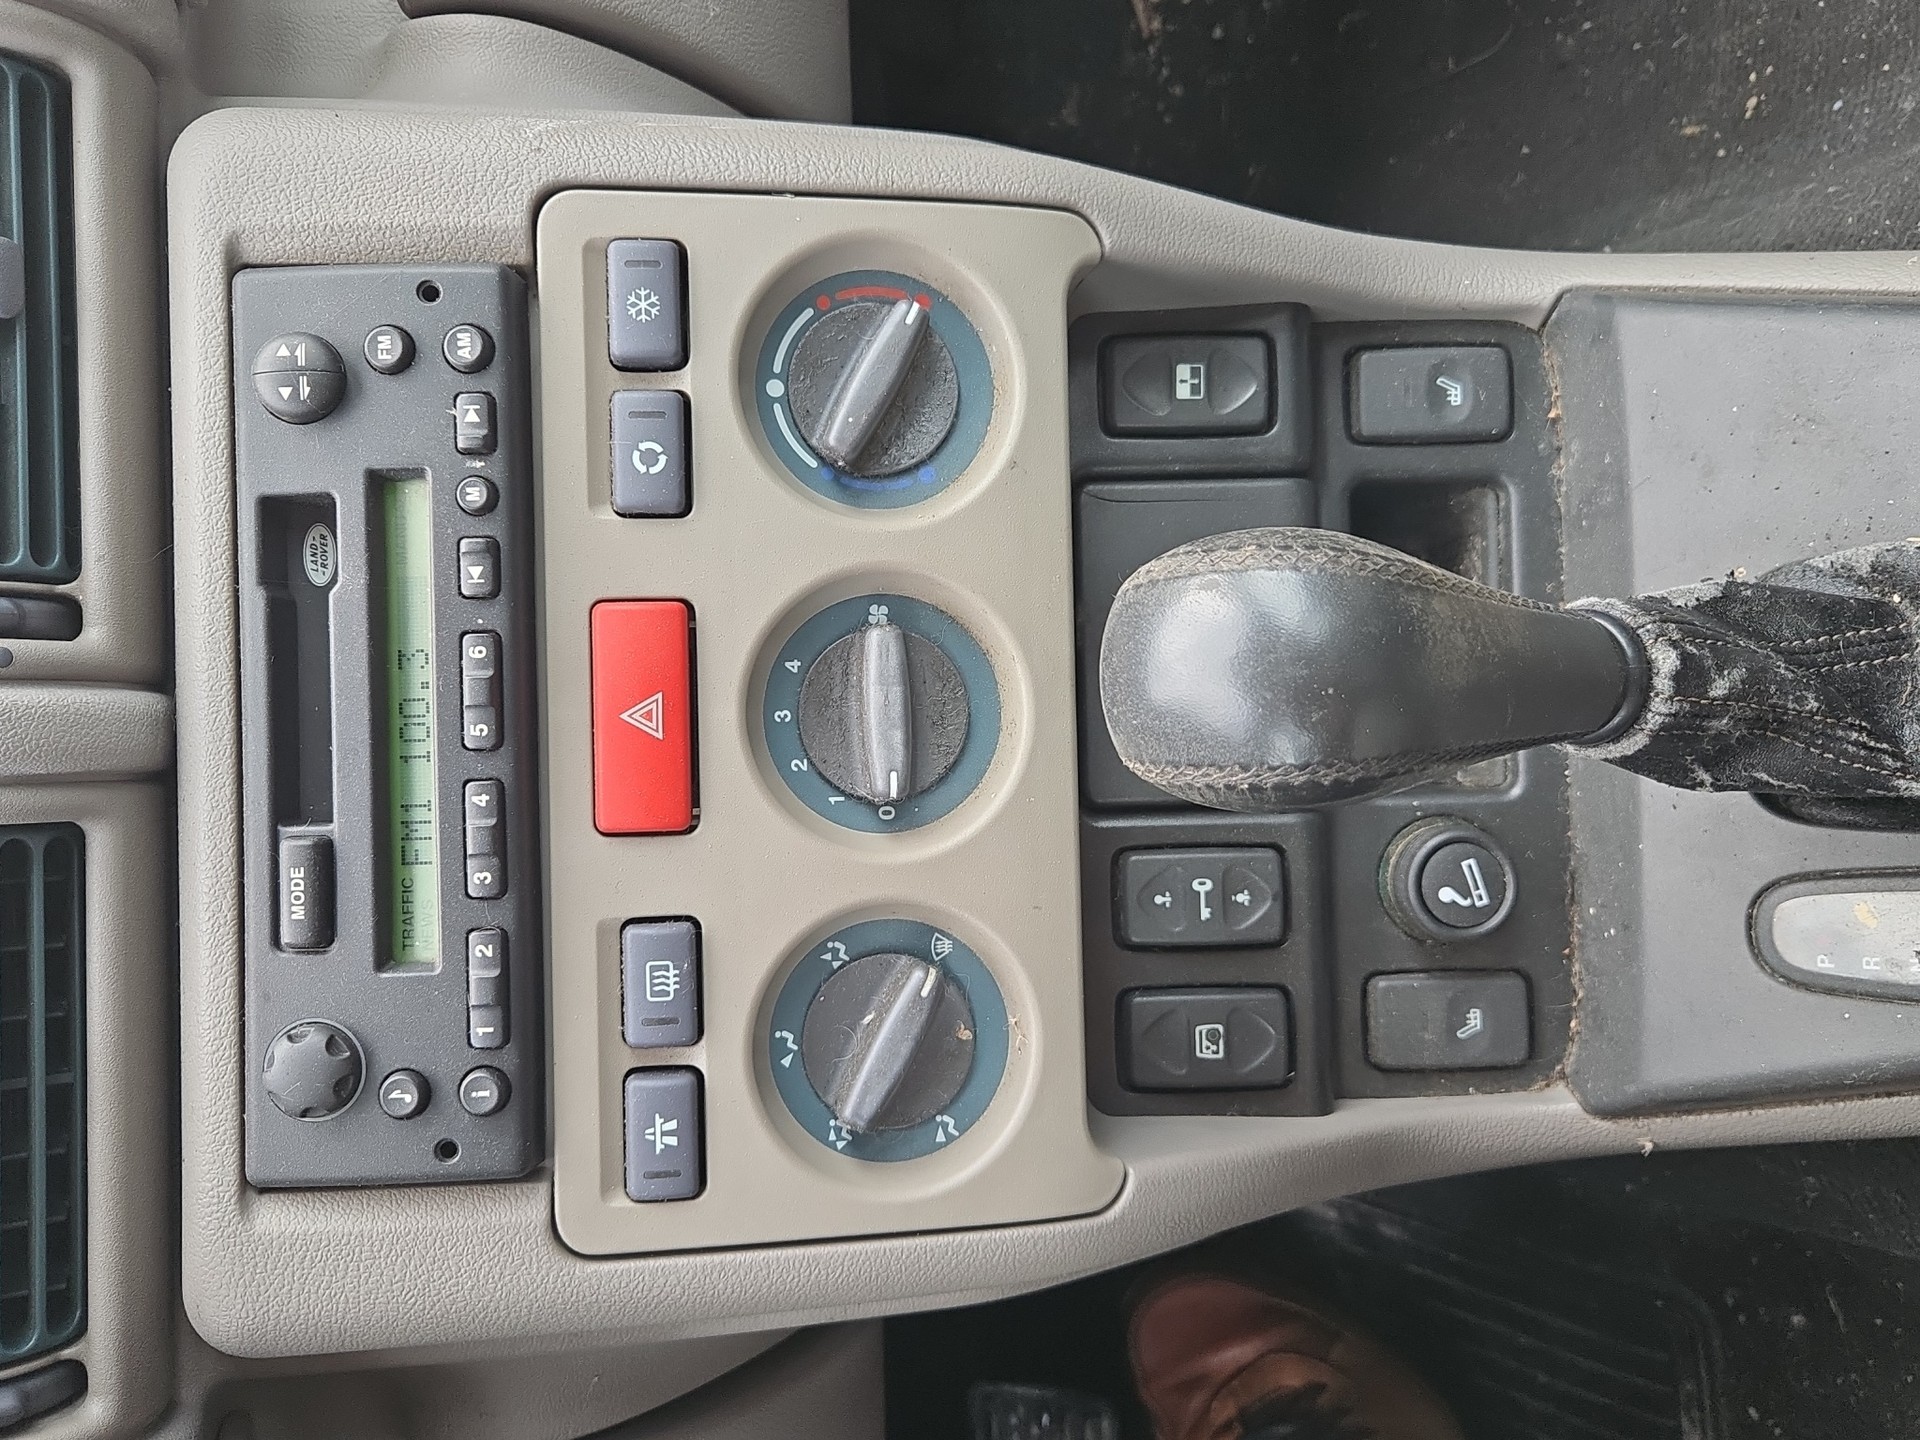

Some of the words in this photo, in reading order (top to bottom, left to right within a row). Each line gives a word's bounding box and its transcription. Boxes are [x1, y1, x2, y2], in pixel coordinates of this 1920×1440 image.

[377, 335, 392, 360] FM
[456, 332, 472, 359] AM
[465, 486, 480, 501] M
[468, 645, 487, 659] 6
[784, 659, 802, 673] 4
[397, 649, 431, 764] 100.3
[774, 709, 792, 723] 3
[469, 723, 489, 737] 5
[790, 758, 808, 772] 2
[471, 793, 490, 807] 4
[828, 795, 845, 805] 1
[878, 806, 896, 820] 0
[400, 800, 433, 866] FM1
[473, 871, 492, 885] 3
[290, 867, 305, 919] MODE
[401, 877, 415, 951] TRAFFIC
[474, 944, 493, 958] 2
[1816, 954, 1835, 968] P
[1862, 956, 1881, 970] R
[476, 1026, 494, 1037] 1
